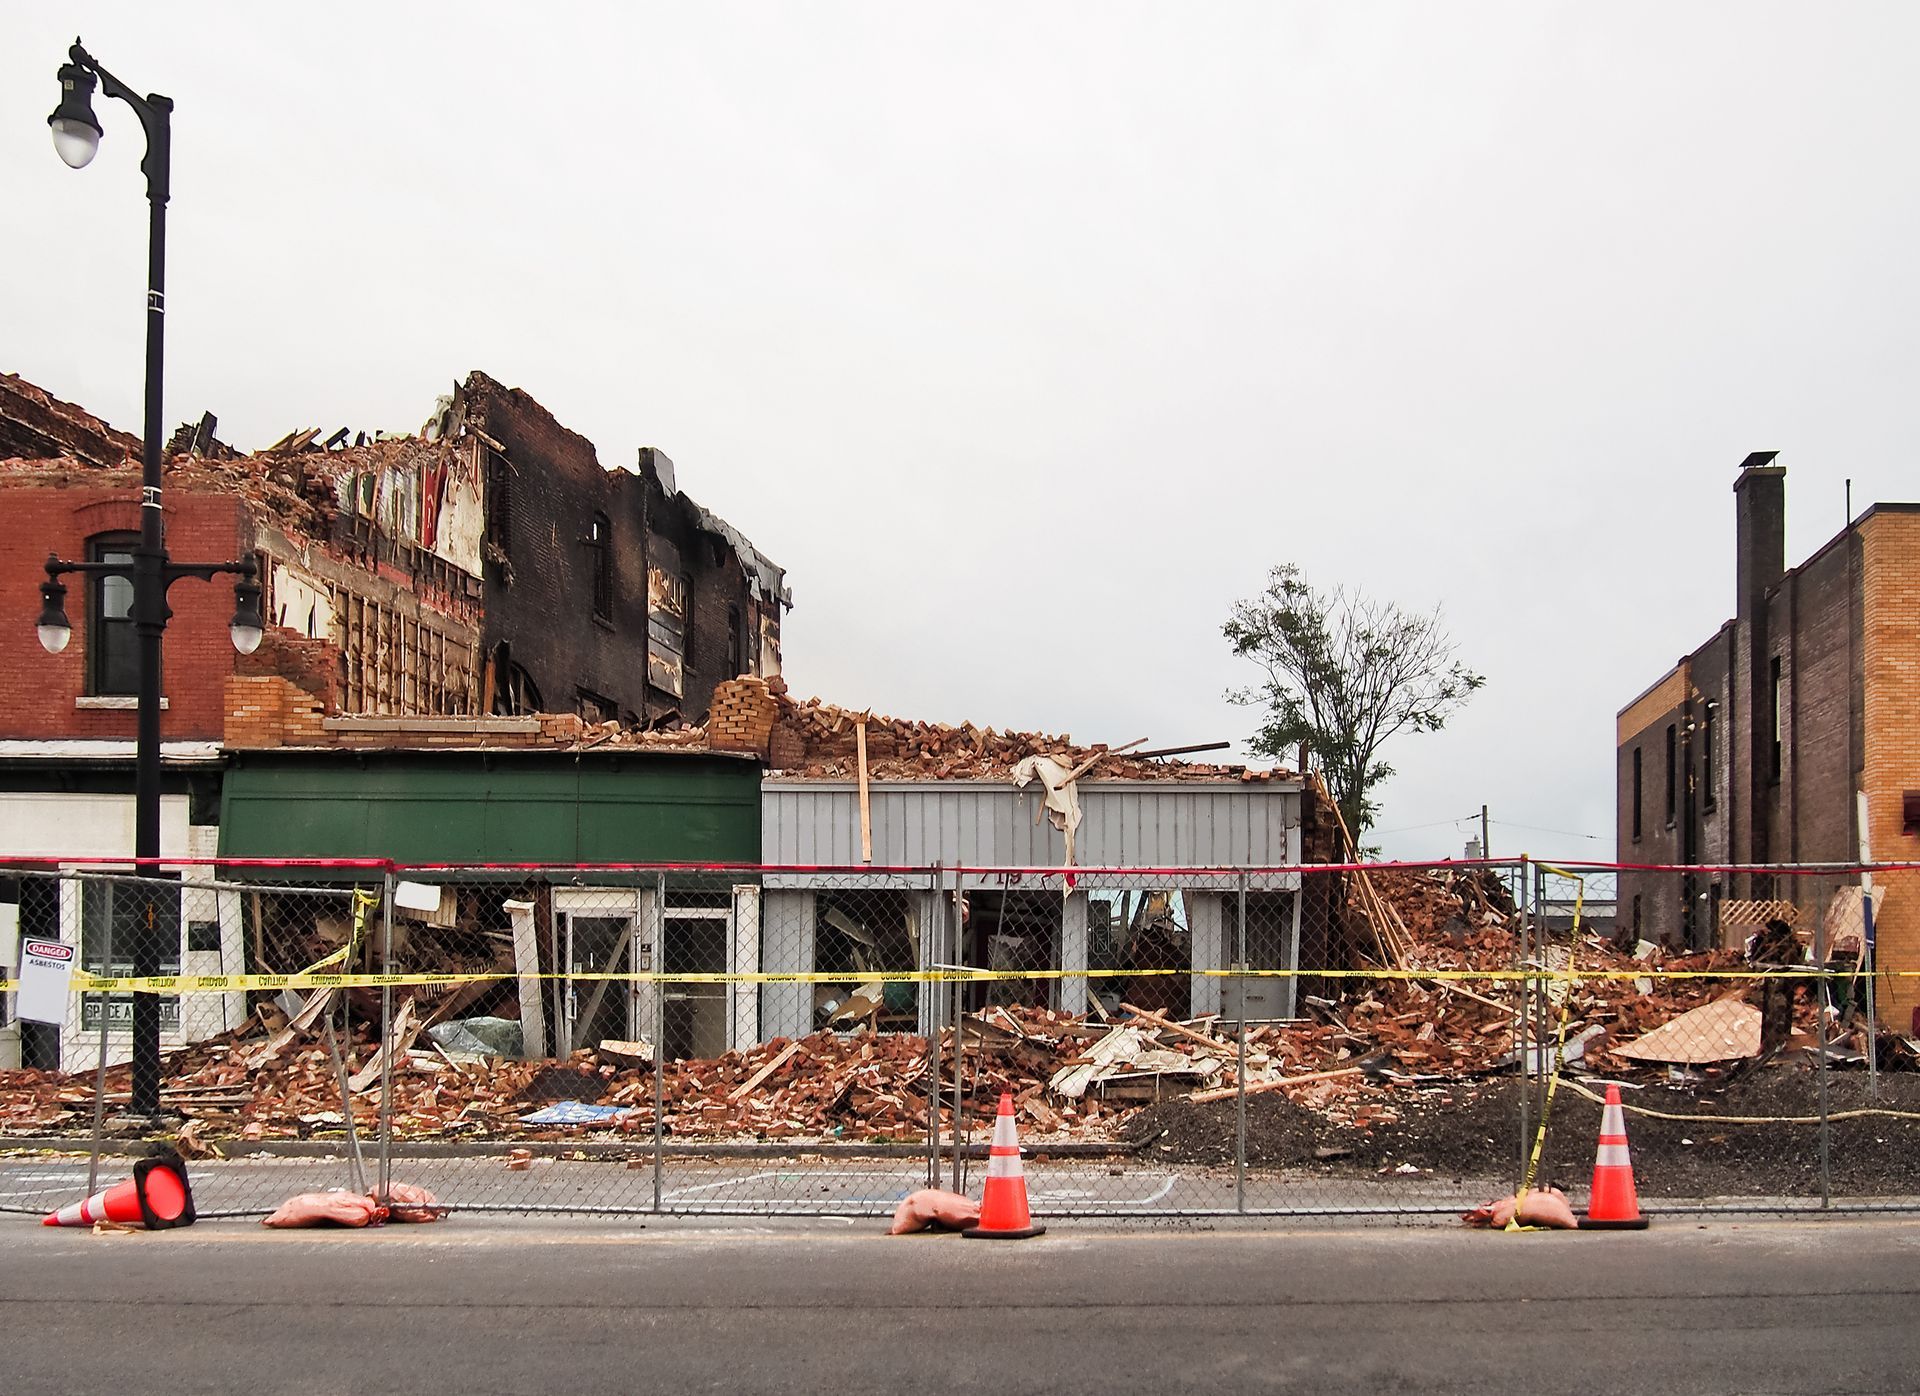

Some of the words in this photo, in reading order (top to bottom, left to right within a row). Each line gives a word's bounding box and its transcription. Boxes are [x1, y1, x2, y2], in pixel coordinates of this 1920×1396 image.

[32, 944, 67, 957] DANGER
[29, 959, 66, 970] ASBESTOS
[86, 1004, 121, 1019] SPCE
